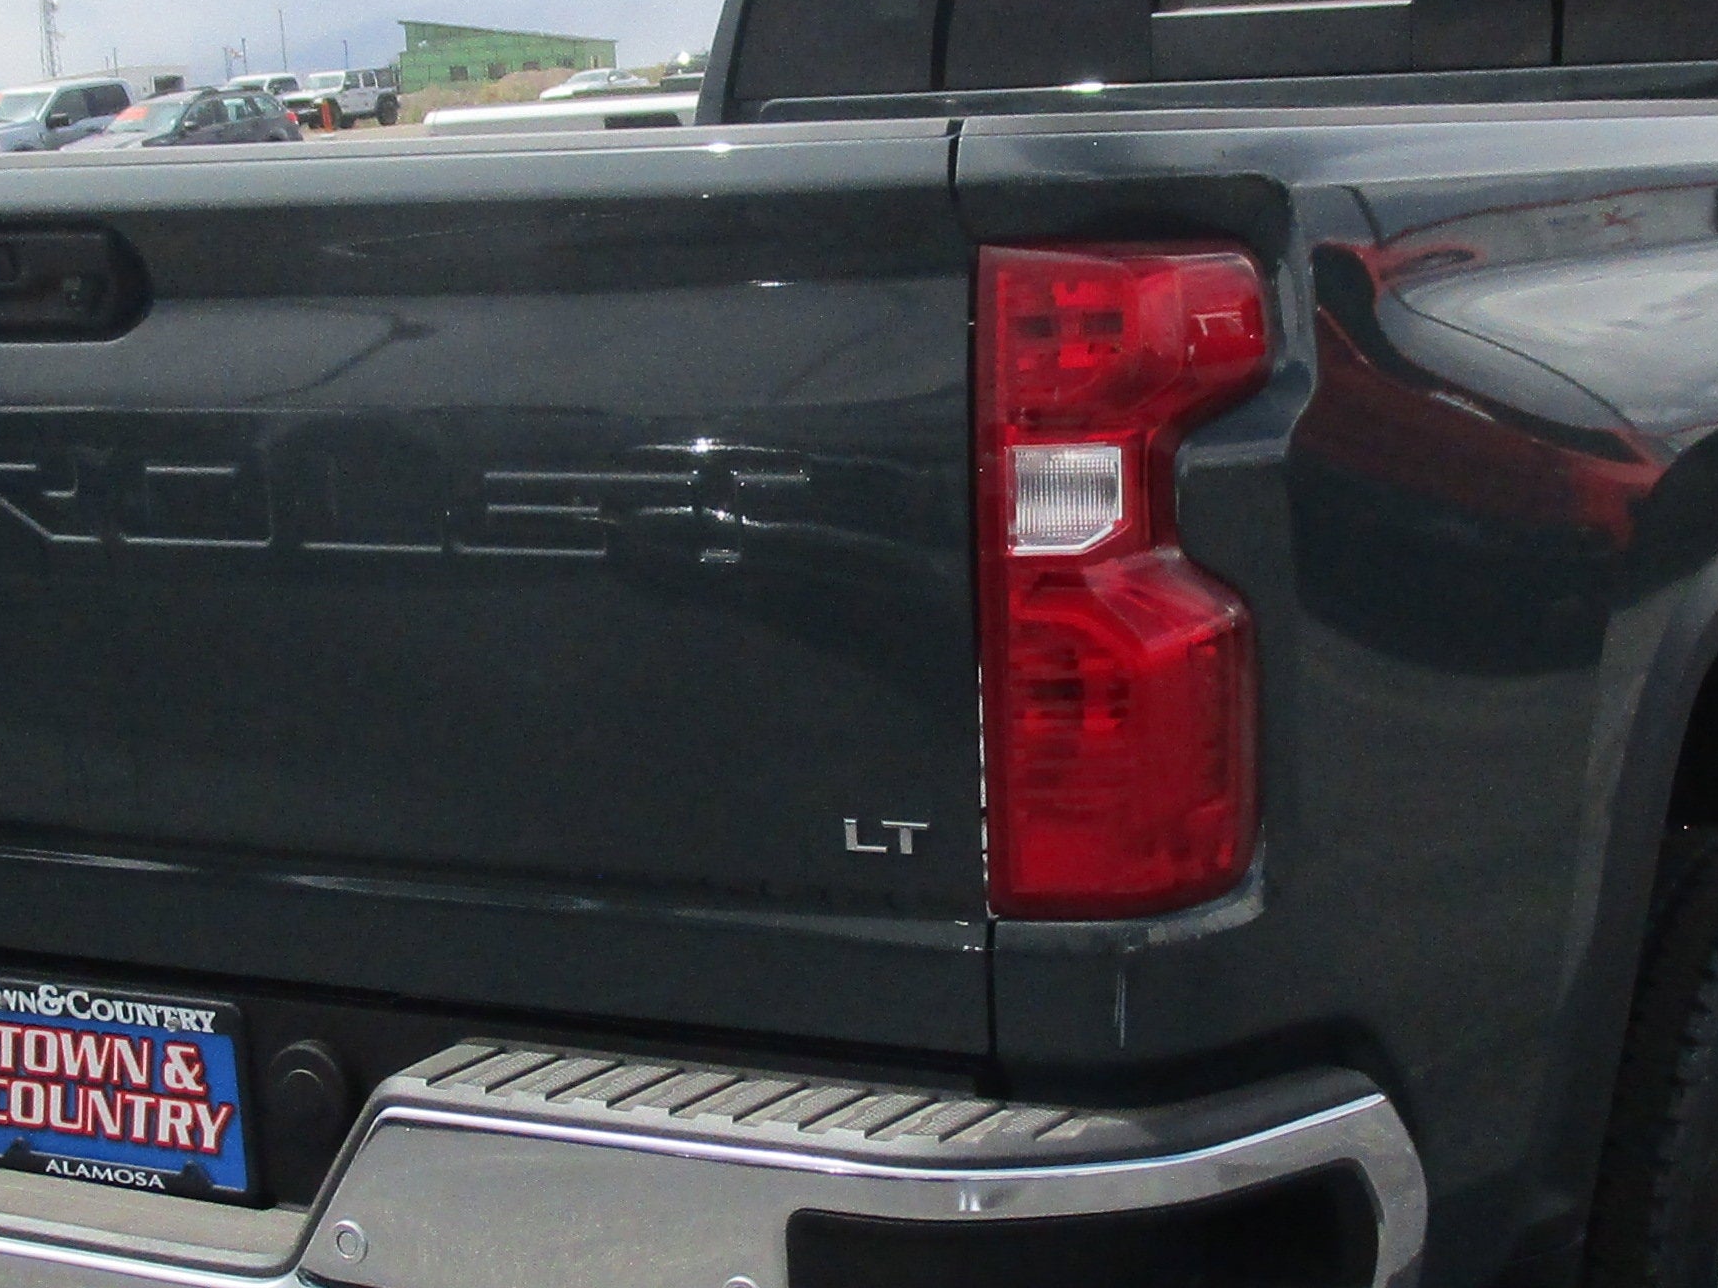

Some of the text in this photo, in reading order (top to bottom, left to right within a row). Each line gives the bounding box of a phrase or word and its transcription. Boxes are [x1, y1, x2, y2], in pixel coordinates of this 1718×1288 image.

[843, 817, 929, 854] LT
[162, 1040, 207, 1096] &
[45, 1158, 167, 1191] ALAMOSA
